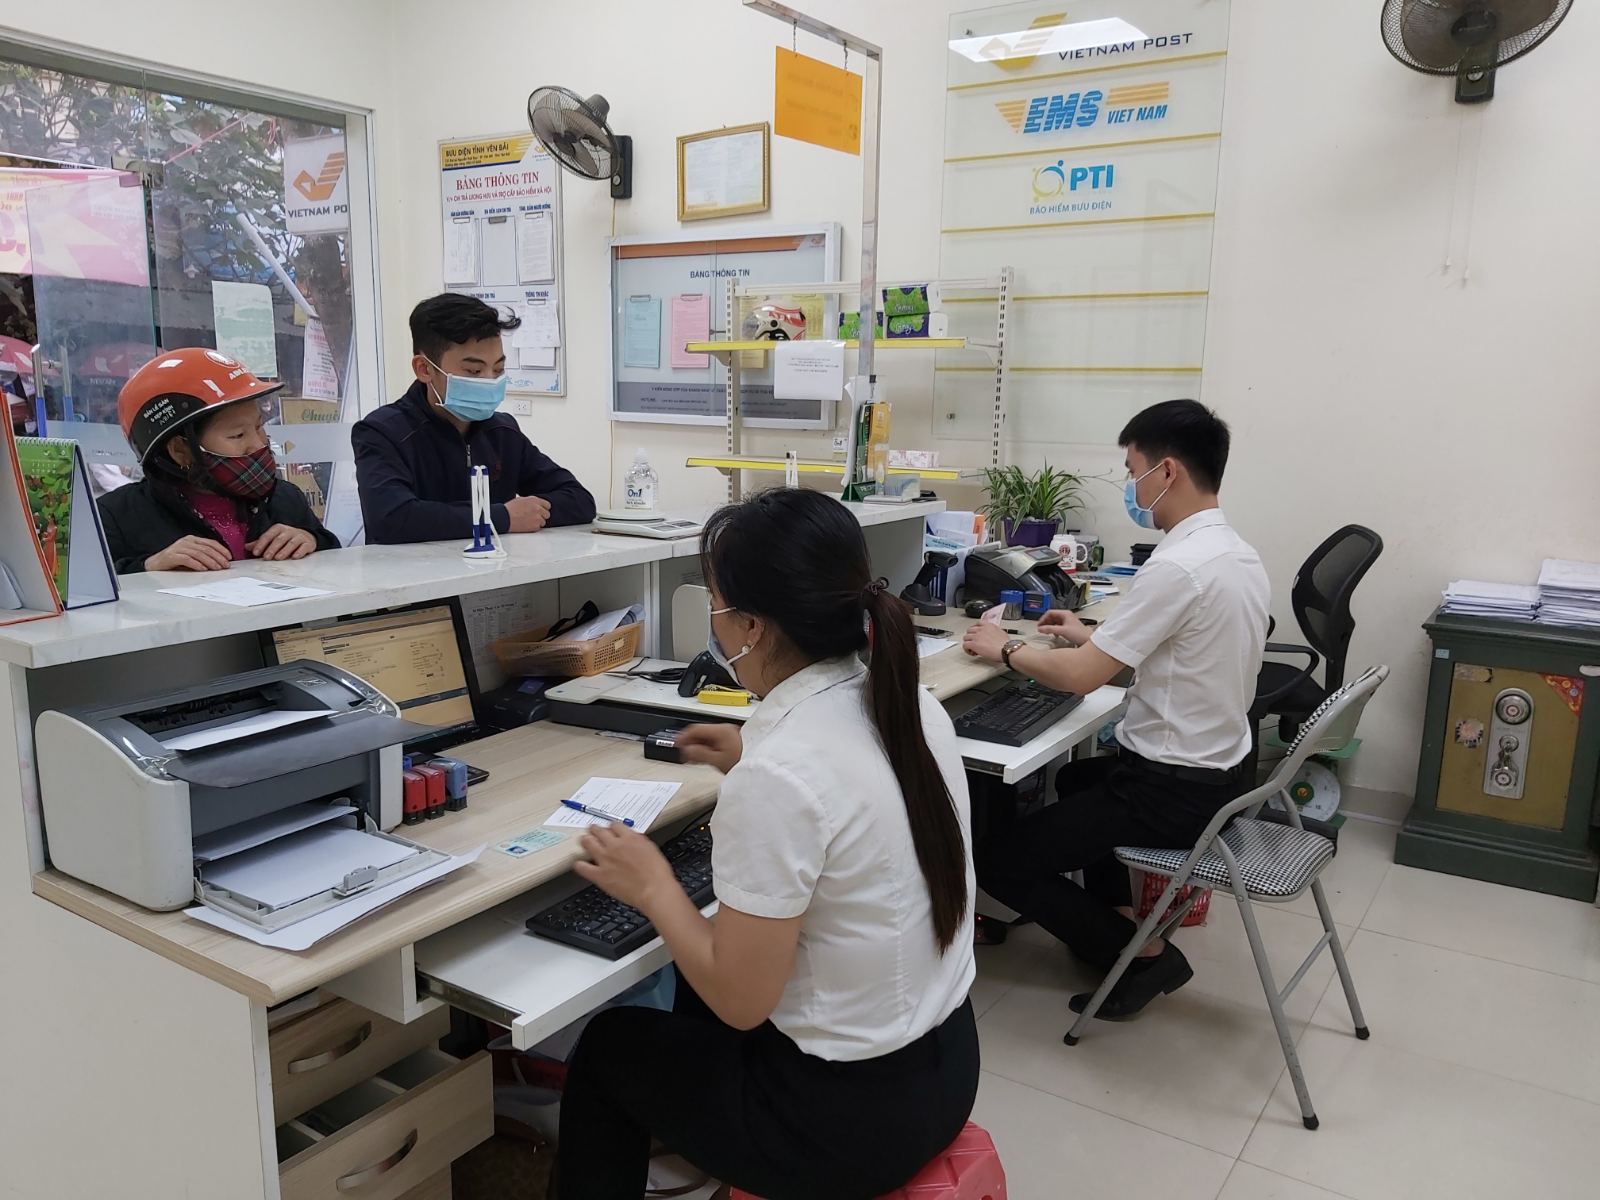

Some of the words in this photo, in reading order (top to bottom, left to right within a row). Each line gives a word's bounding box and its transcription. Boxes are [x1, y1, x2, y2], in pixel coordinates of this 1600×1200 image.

[1058, 41, 1135, 61] VIETNAM
[1143, 32, 1193, 49] POST
[1023, 90, 1103, 134] EMS
[1107, 107, 1135, 125] VIET
[1137, 105, 1168, 120] NAM
[456, 174, 482, 191] BẢNG
[484, 172, 519, 188] THÔNG
[521, 170, 540, 185] TIN
[1070, 164, 1115, 191] PTI
[287, 206, 330, 218] VIETNAM
[710, 268, 737, 278] THÔNG
[738, 268, 750, 276] TIN
